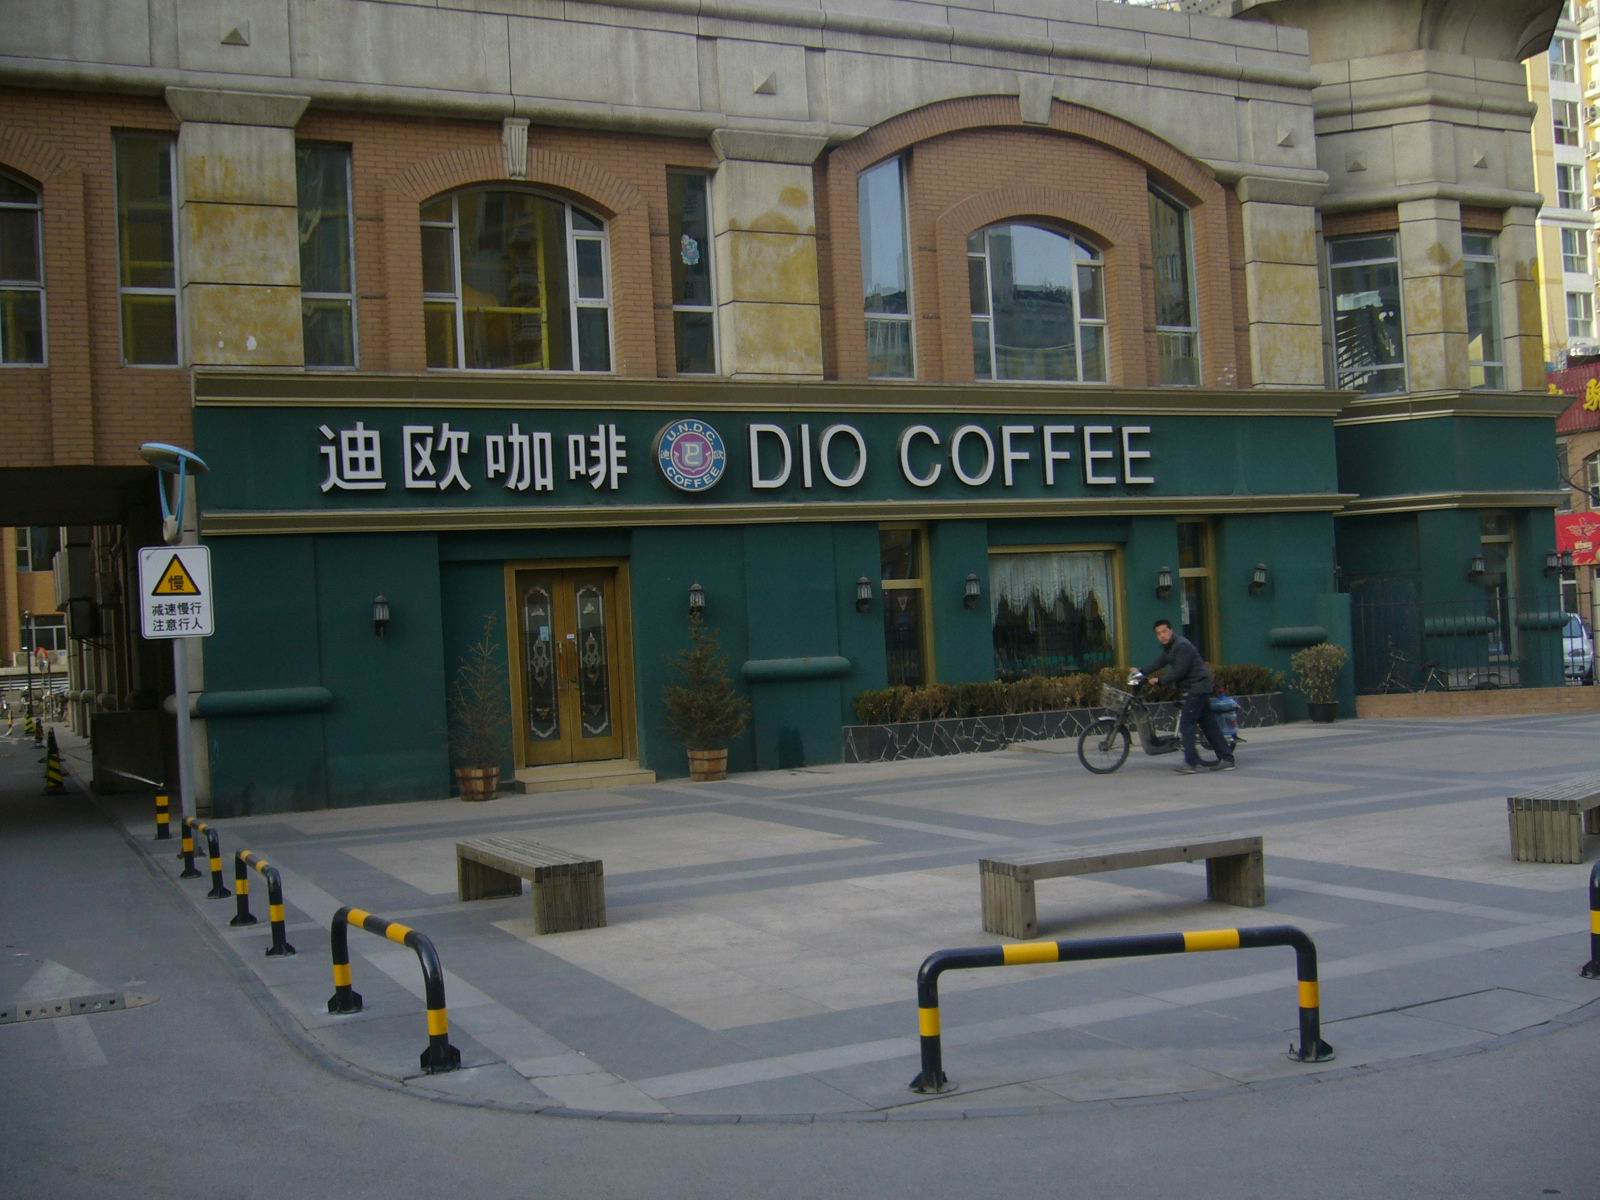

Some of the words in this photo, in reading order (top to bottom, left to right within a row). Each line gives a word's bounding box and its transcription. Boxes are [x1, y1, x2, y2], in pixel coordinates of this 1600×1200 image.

[319, 421, 628, 492] 迪欧咖啡
[748, 423, 867, 488] DIO
[899, 425, 1155, 487] COFFEE
[666, 466, 719, 488] COFFEE
[168, 575, 184, 591] 慢
[151, 602, 202, 616] 减速慢行
[152, 617, 203, 632] 注意行人
